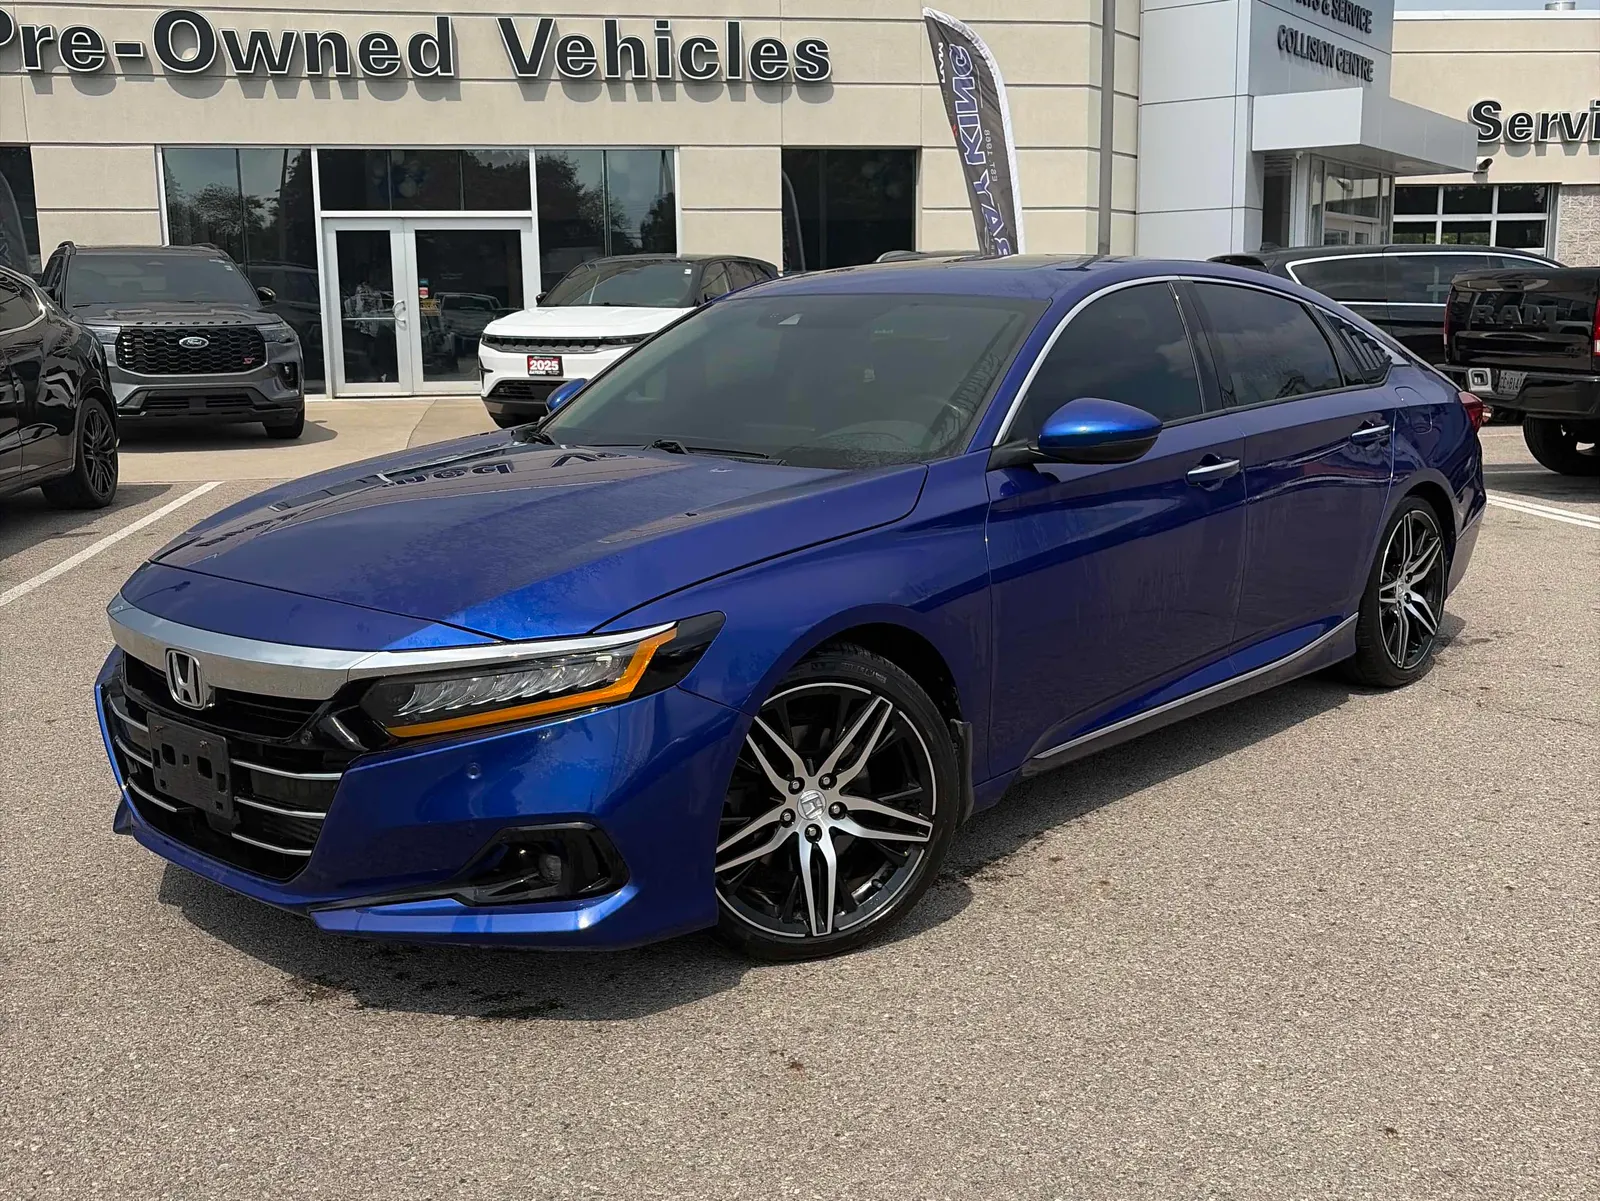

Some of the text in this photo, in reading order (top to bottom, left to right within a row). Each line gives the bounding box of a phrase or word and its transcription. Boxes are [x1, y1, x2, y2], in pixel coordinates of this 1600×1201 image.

[1331, 0, 1372, 33] SERVICE
[497, 17, 830, 82] Vehicles
[1277, 25, 1374, 82] COLLISION CENTRE
[1470, 305, 1558, 324] RAM
[530, 360, 559, 370] 2025
